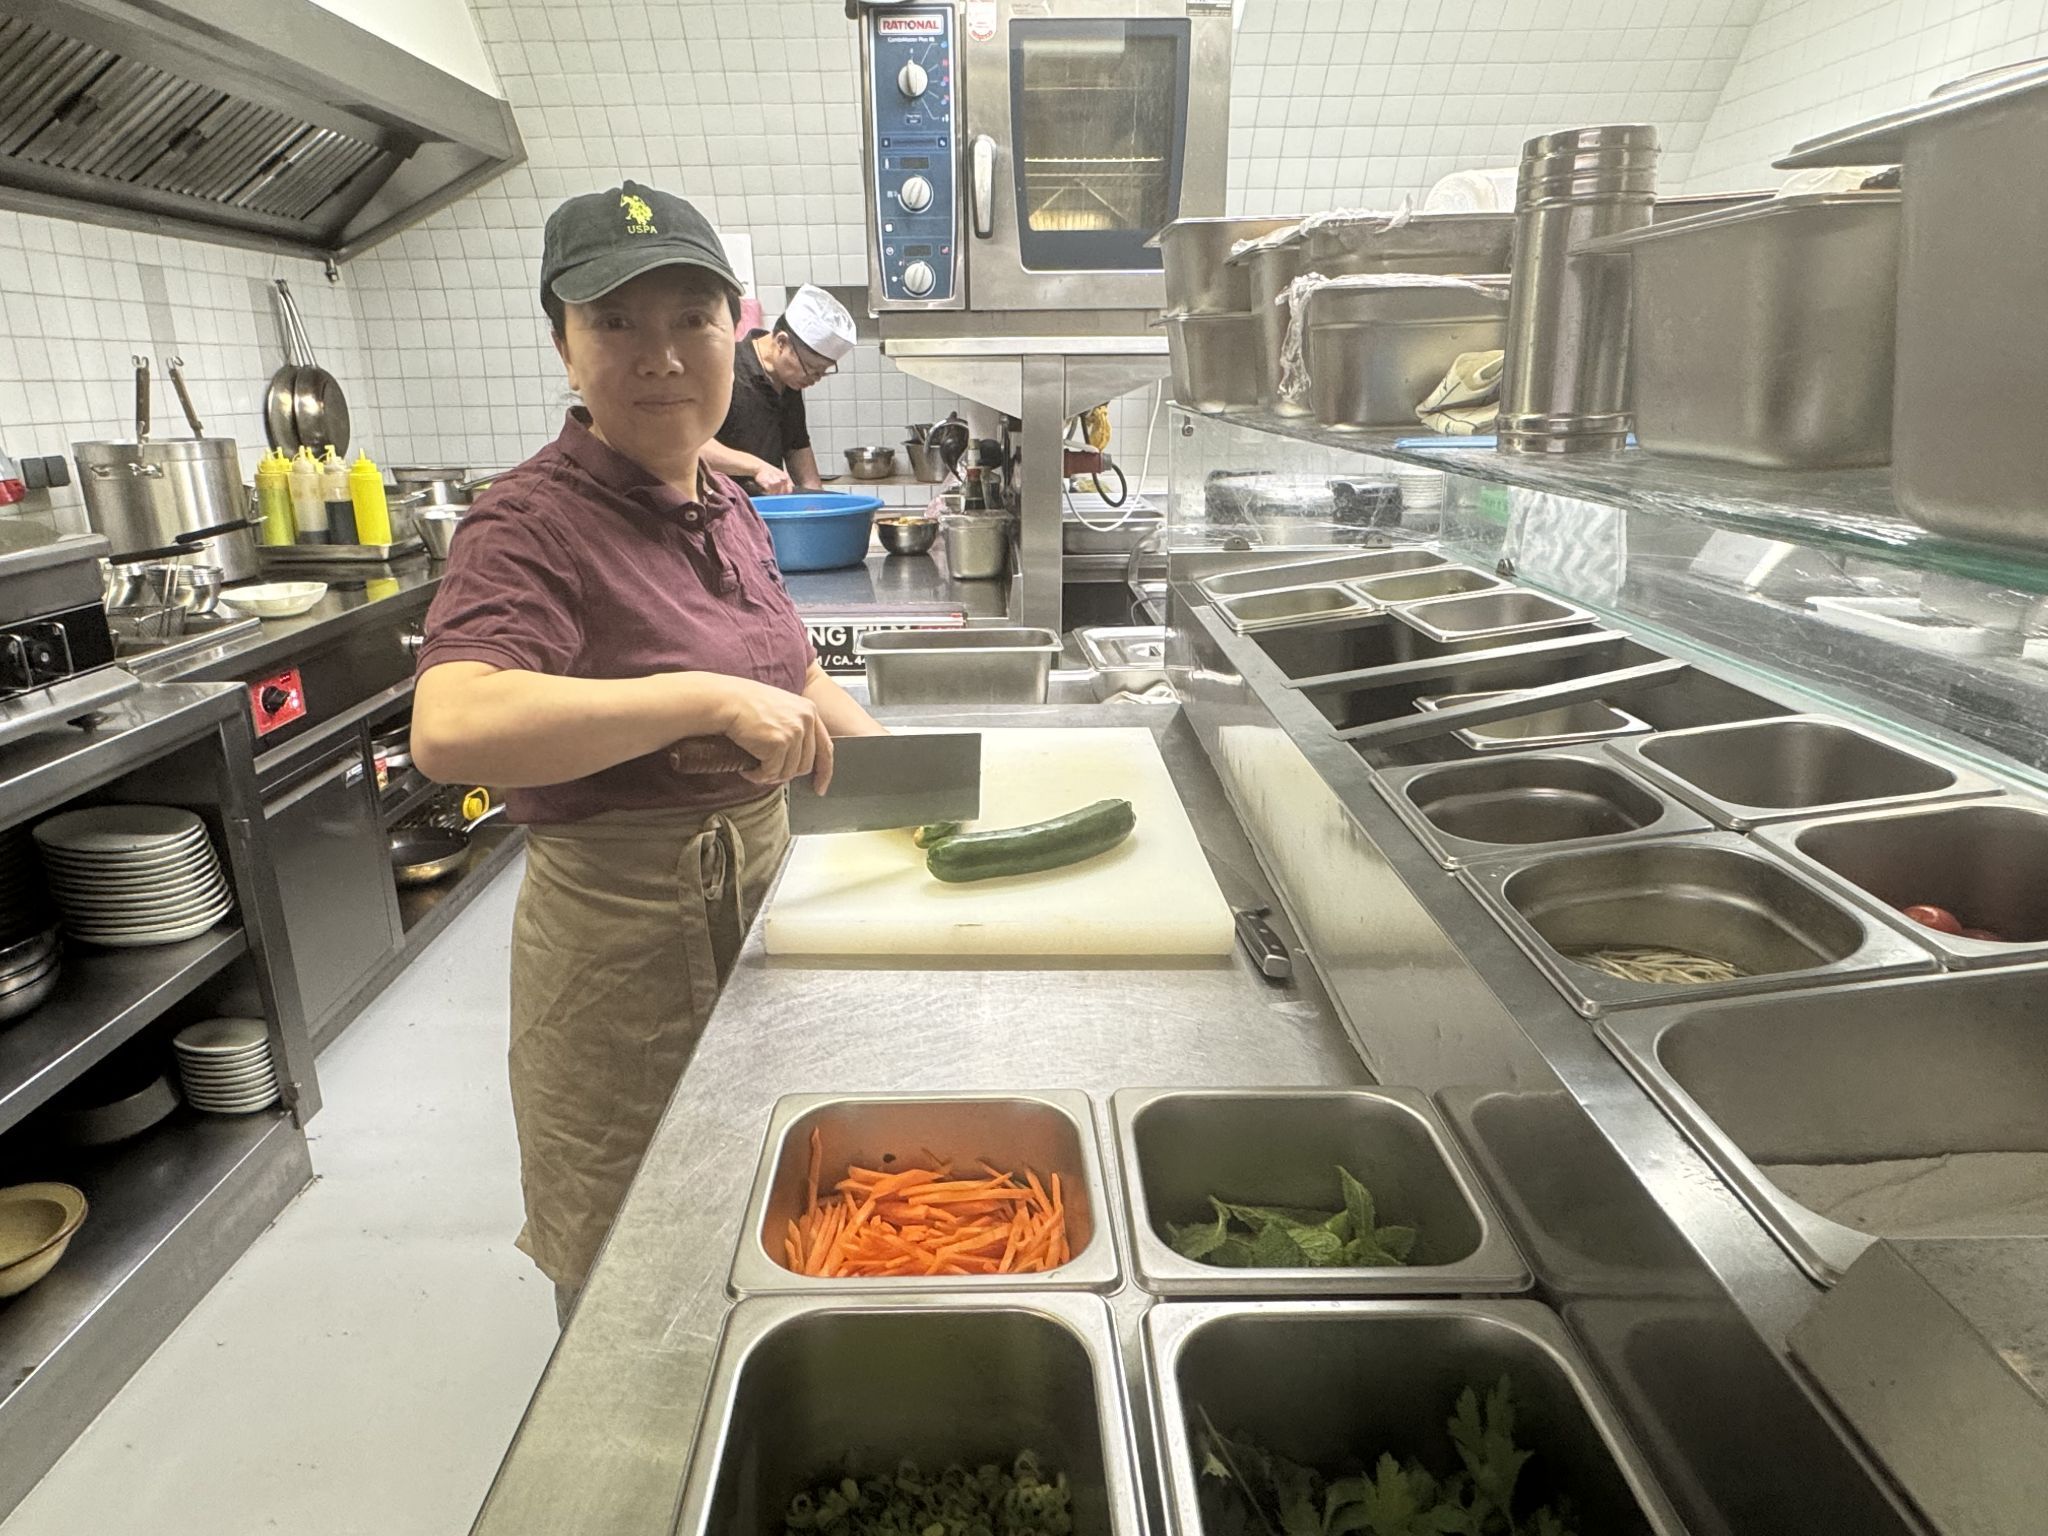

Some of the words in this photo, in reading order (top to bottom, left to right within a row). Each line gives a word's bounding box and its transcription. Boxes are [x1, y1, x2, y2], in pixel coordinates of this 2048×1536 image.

[883, 20, 939, 30] RATIONAL
[627, 225, 658, 234] USPA
[807, 626, 847, 646] NG
[832, 655, 854, 666] CA.
